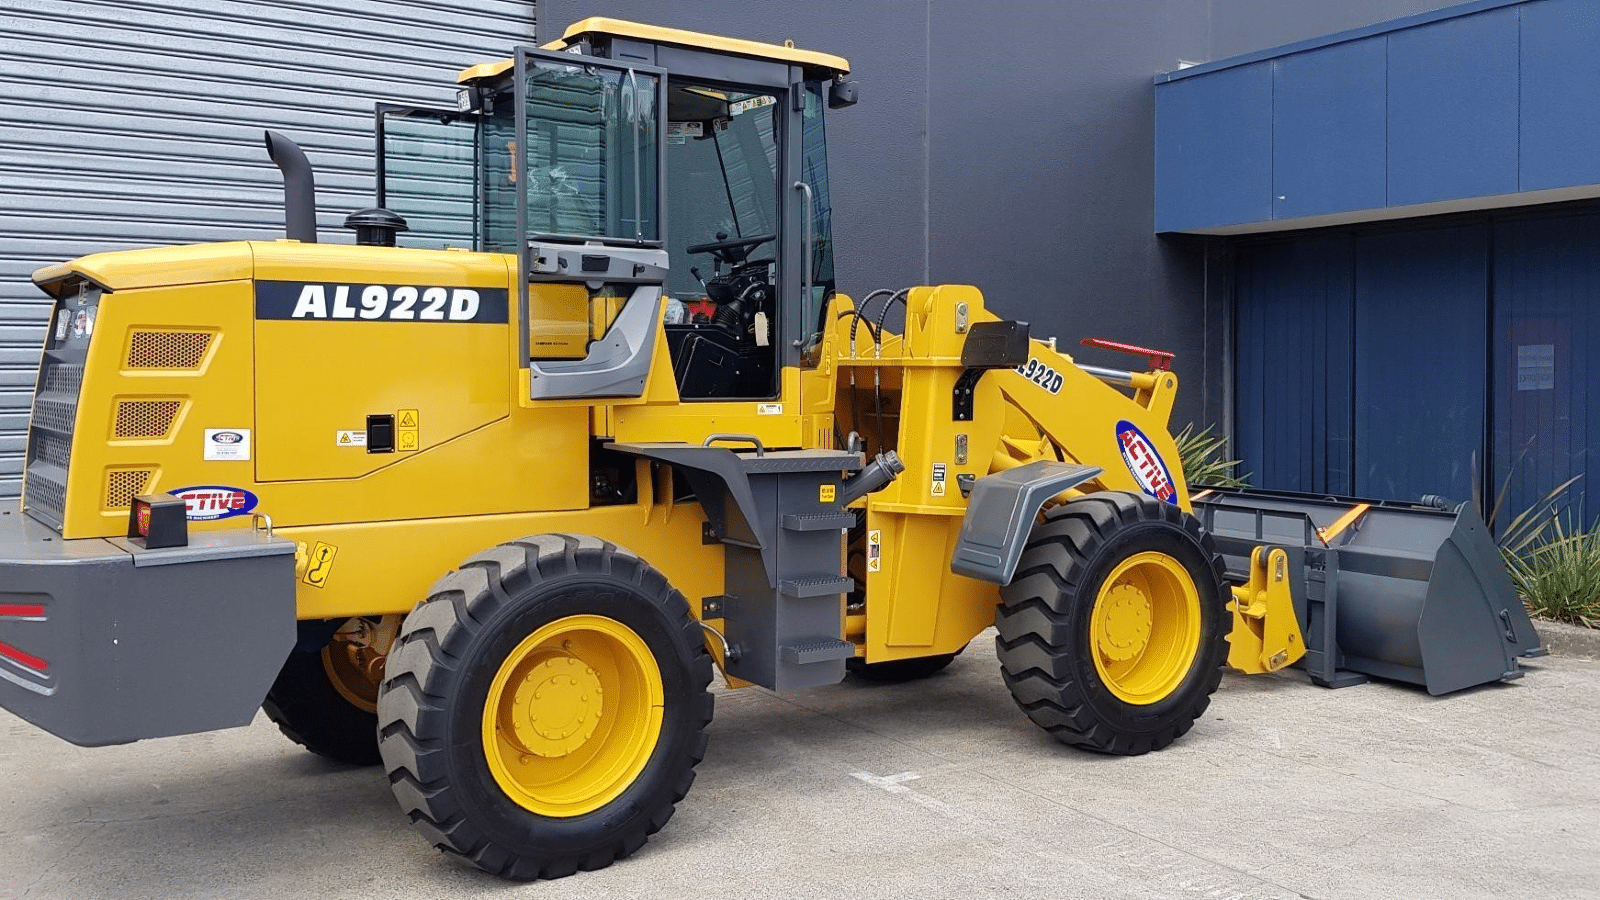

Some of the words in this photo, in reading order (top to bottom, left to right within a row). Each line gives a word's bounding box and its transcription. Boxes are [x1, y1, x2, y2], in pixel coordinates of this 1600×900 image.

[291, 284, 480, 321] AL922D
[1017, 359, 1063, 393] L922D
[1118, 429, 1175, 501] ACTIVE
[181, 491, 246, 511] CTIVE
